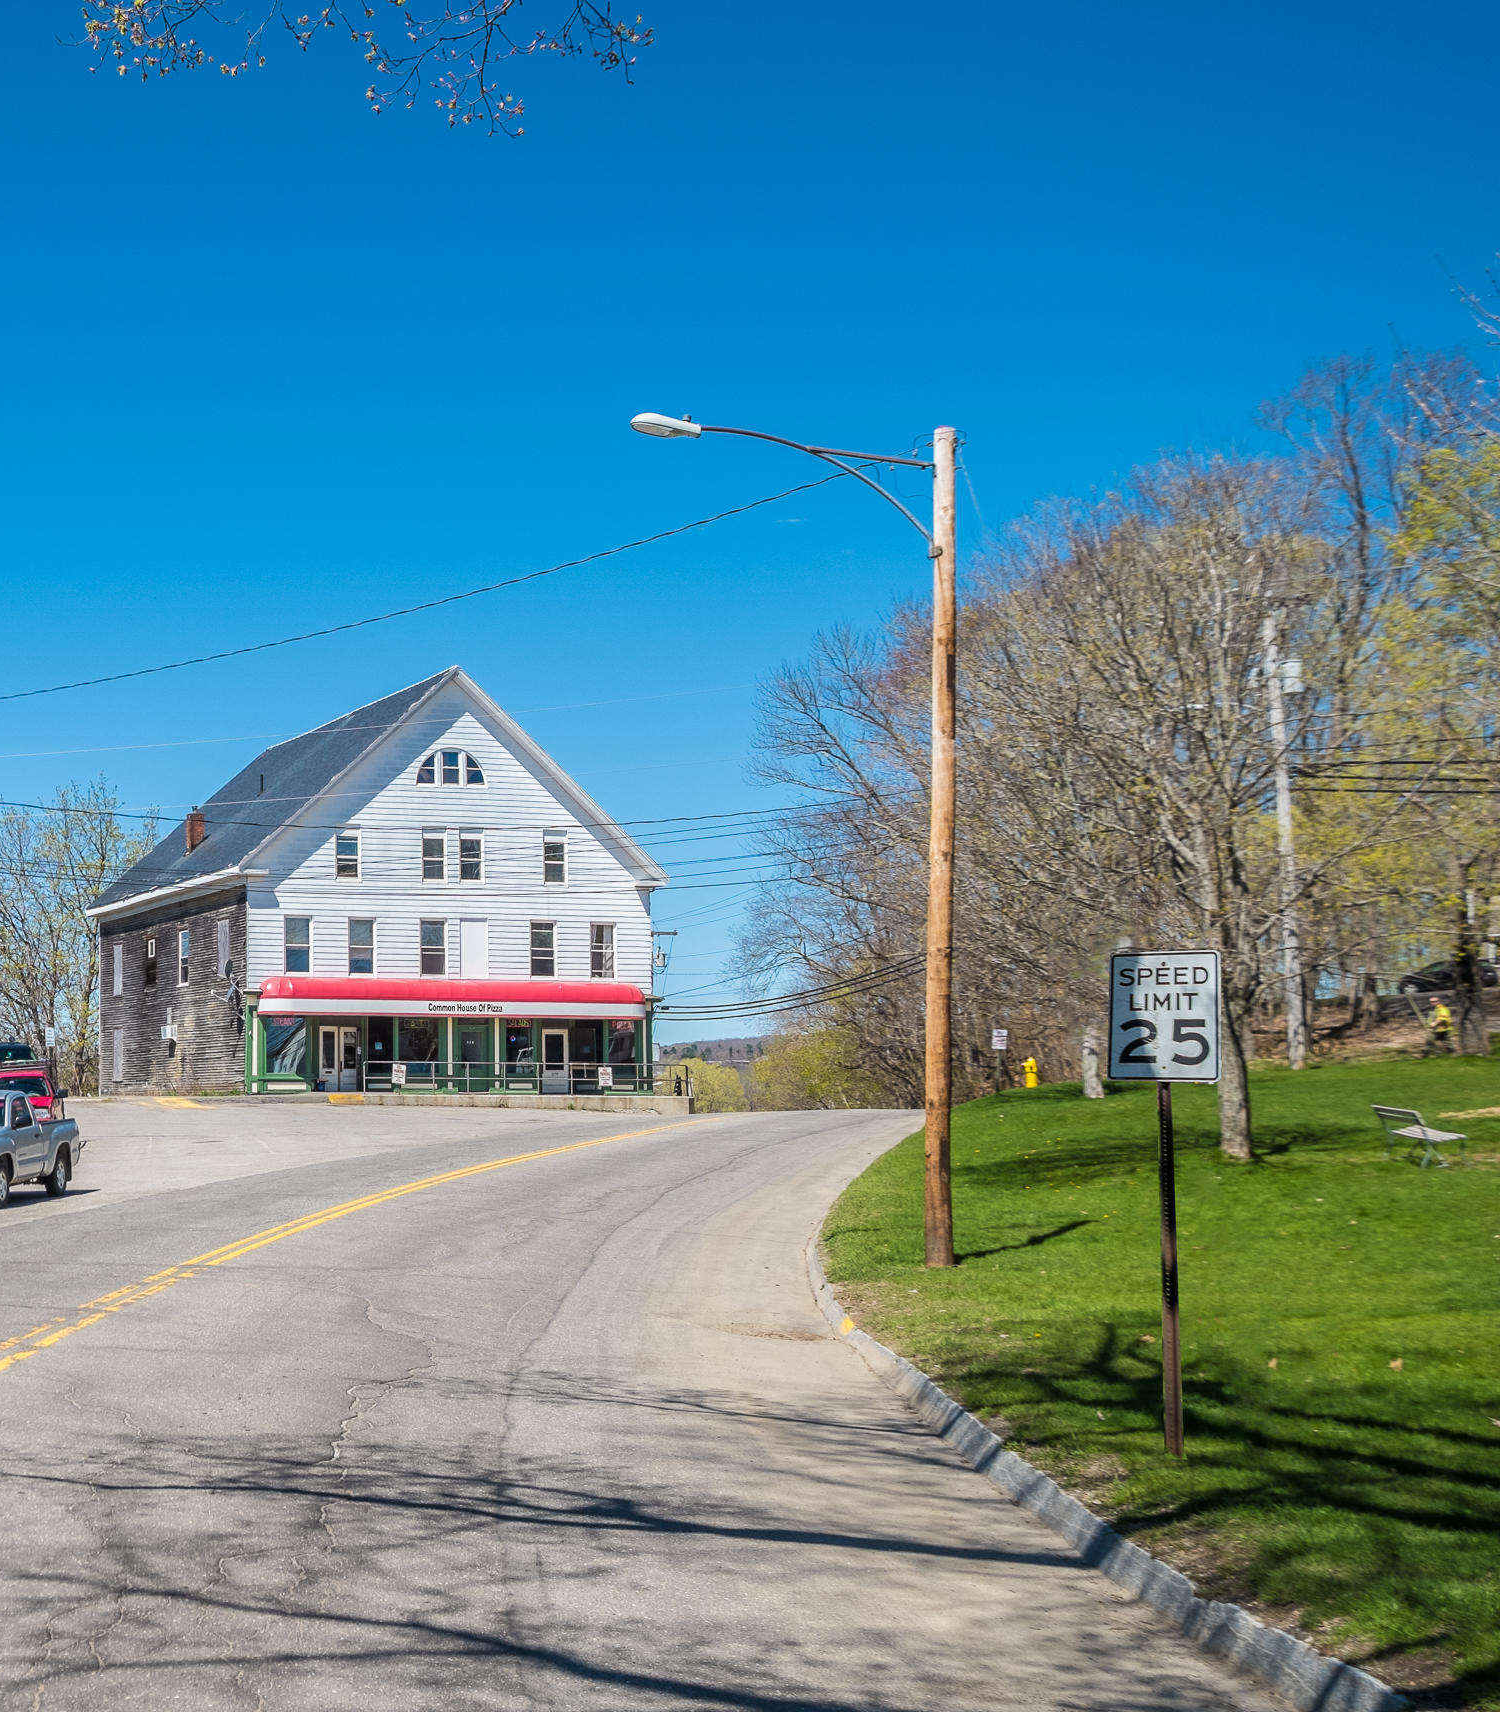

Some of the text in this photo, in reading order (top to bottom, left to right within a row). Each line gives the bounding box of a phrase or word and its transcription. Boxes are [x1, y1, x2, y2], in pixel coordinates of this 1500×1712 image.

[1119, 967, 1209, 987] SPEED
[428, 1003, 503, 1012] Common House Of Pizza
[1128, 992, 1198, 1011] LIMIT
[1119, 1018, 1210, 1067] 25
